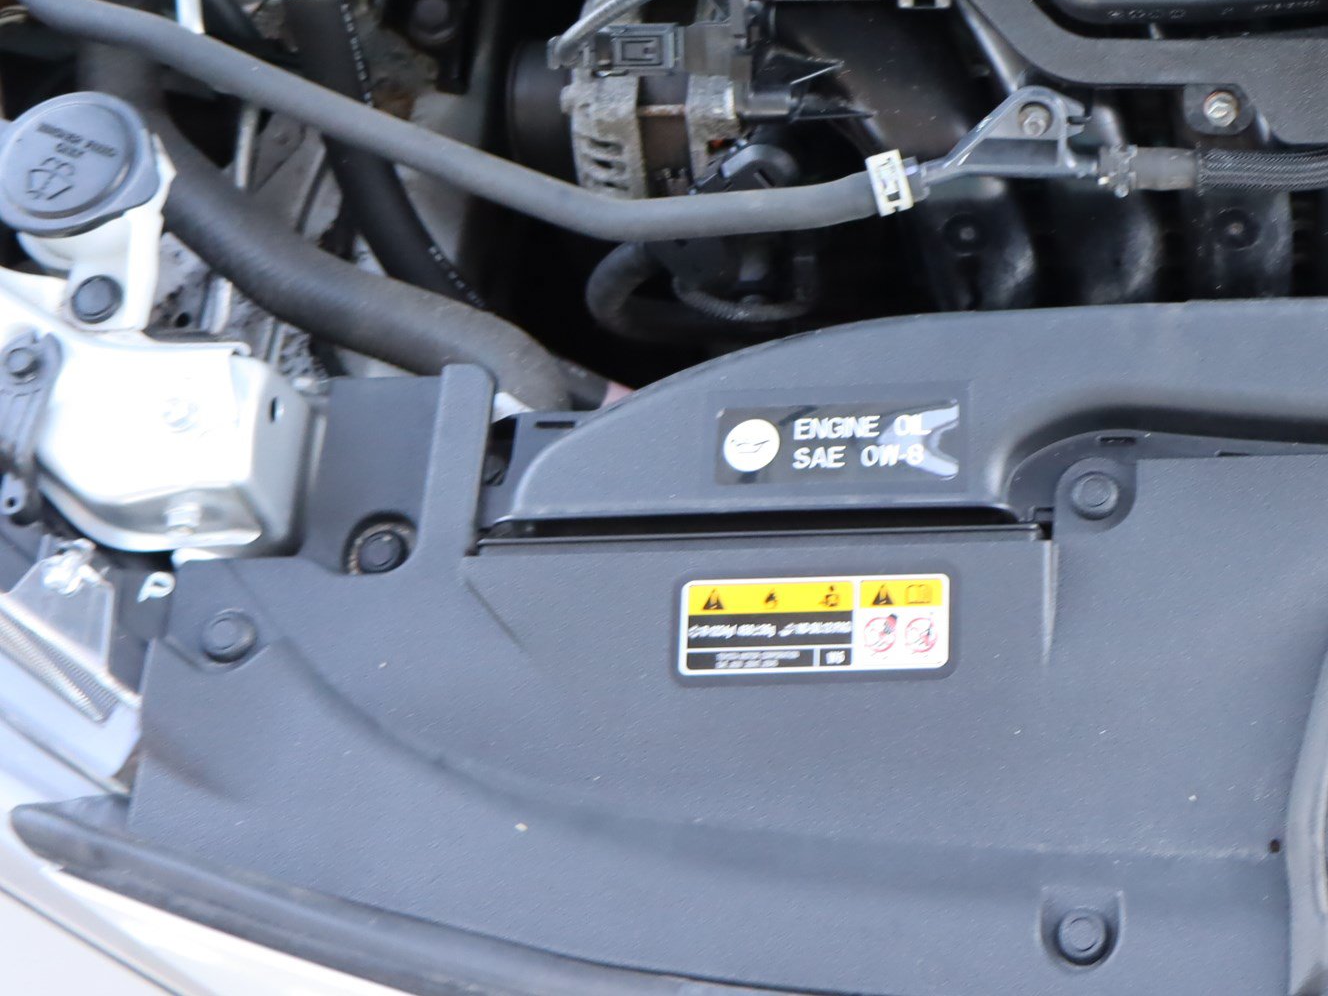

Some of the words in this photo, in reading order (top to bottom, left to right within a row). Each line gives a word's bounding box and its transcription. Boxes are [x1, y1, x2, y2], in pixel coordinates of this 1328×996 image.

[793, 415, 881, 440] ENGINE
[893, 414, 932, 436] OIL
[792, 445, 847, 469] SAE
